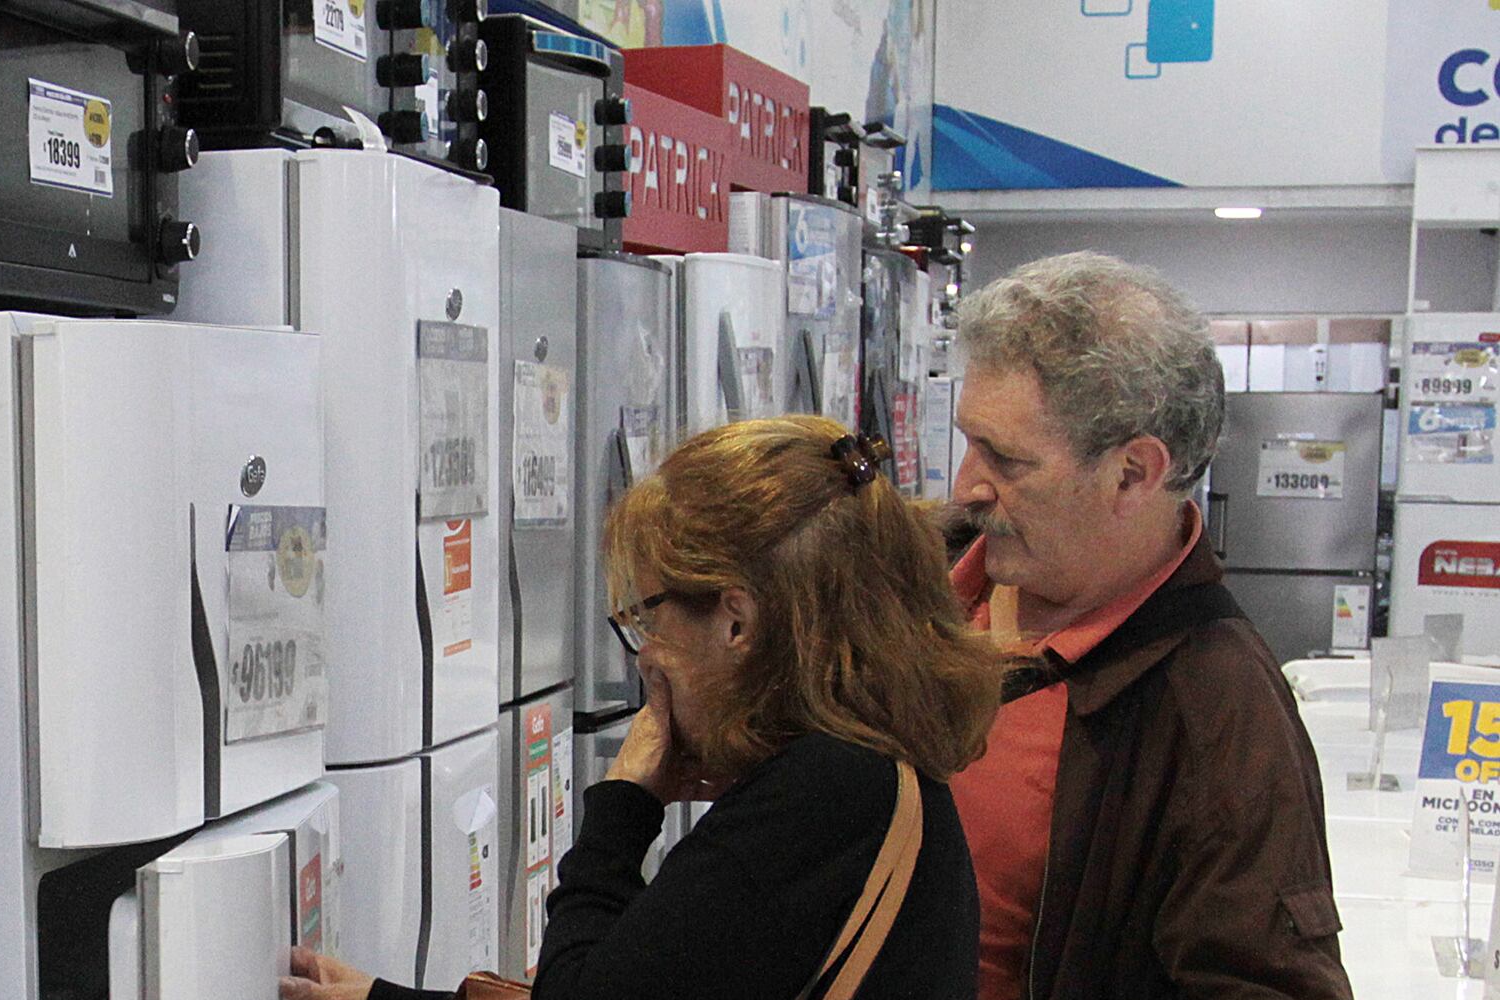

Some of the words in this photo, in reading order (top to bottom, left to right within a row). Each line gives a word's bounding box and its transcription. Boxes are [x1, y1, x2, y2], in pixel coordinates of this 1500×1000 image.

[48, 137, 80, 169] 18399
[728, 81, 804, 174] PATRICK
[629, 125, 725, 222] PATRICK
[1473, 789, 1494, 801] EN
